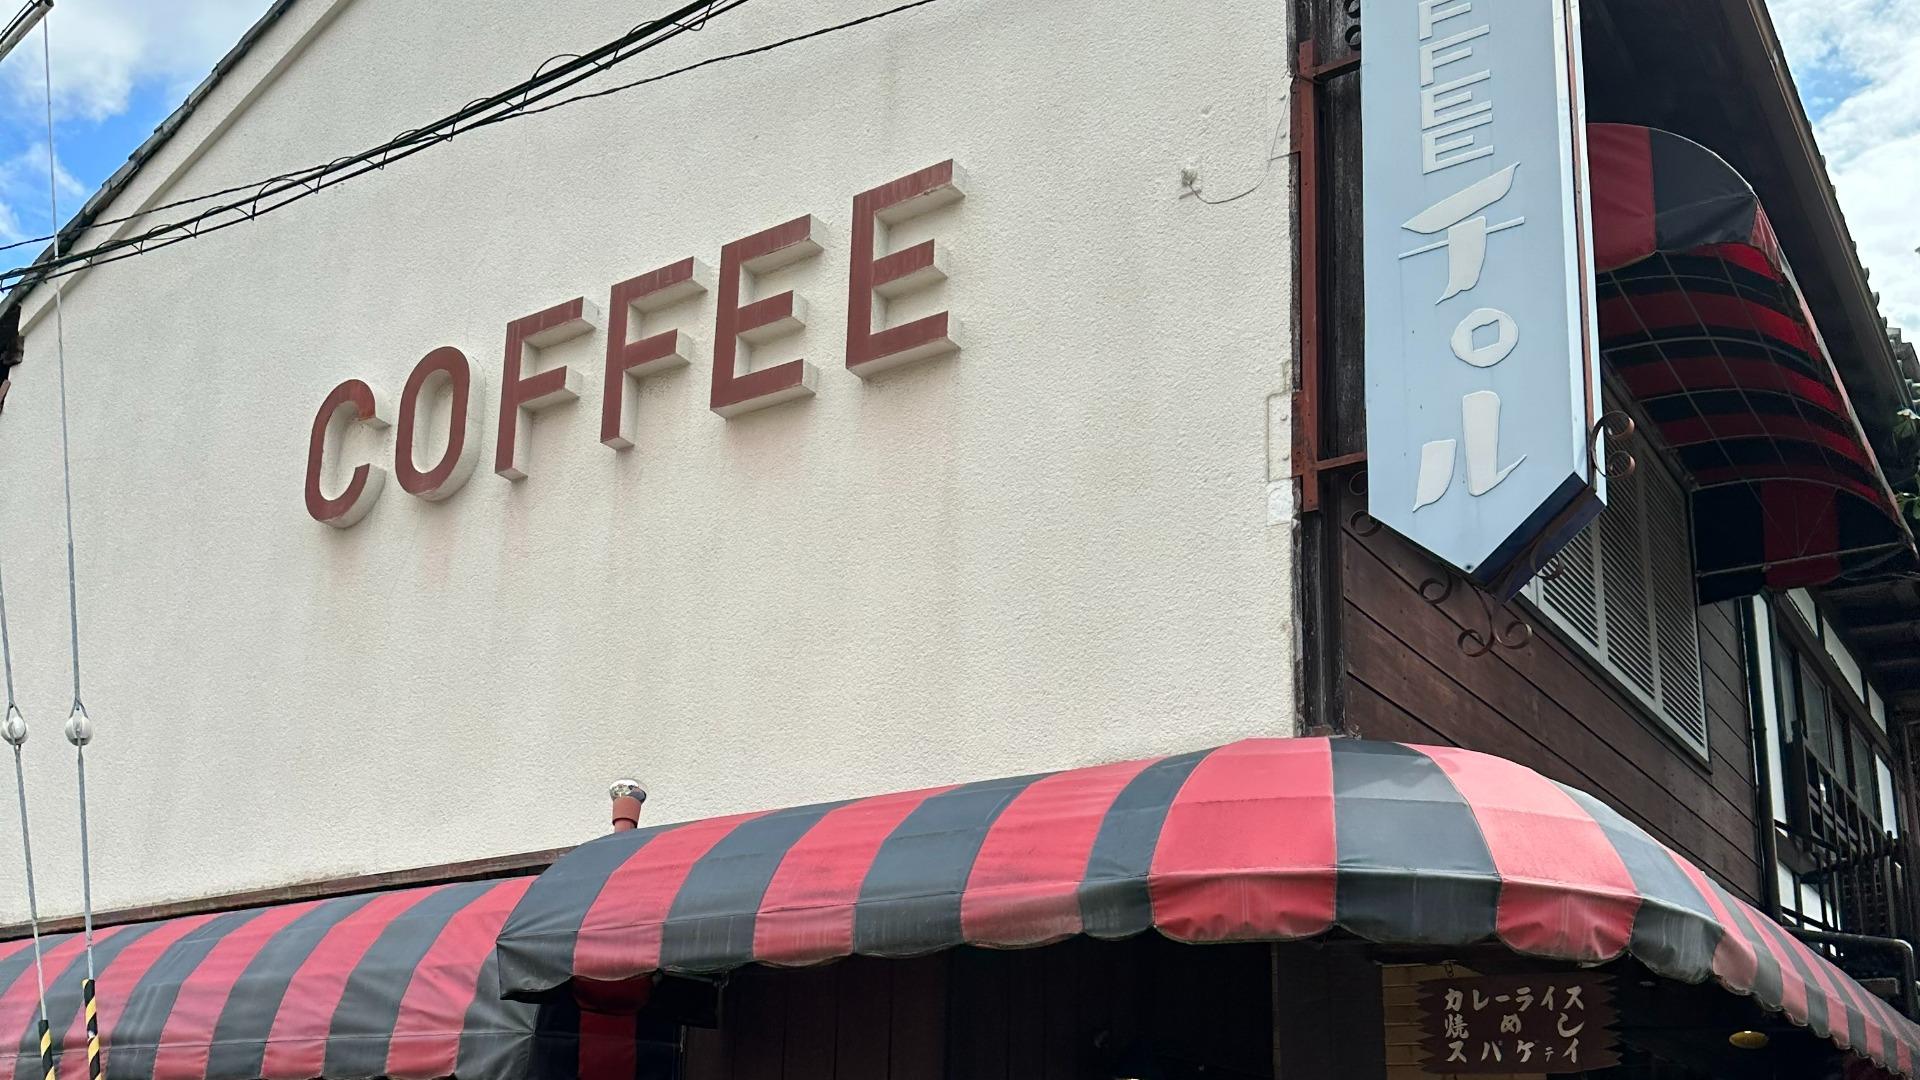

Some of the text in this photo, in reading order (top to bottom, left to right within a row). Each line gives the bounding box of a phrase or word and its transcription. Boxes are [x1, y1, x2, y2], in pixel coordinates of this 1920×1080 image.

[305, 158, 962, 527] COFFEE
[1444, 985, 1584, 1012] カレーライス
[1445, 1013, 1585, 1039] 焼めし
